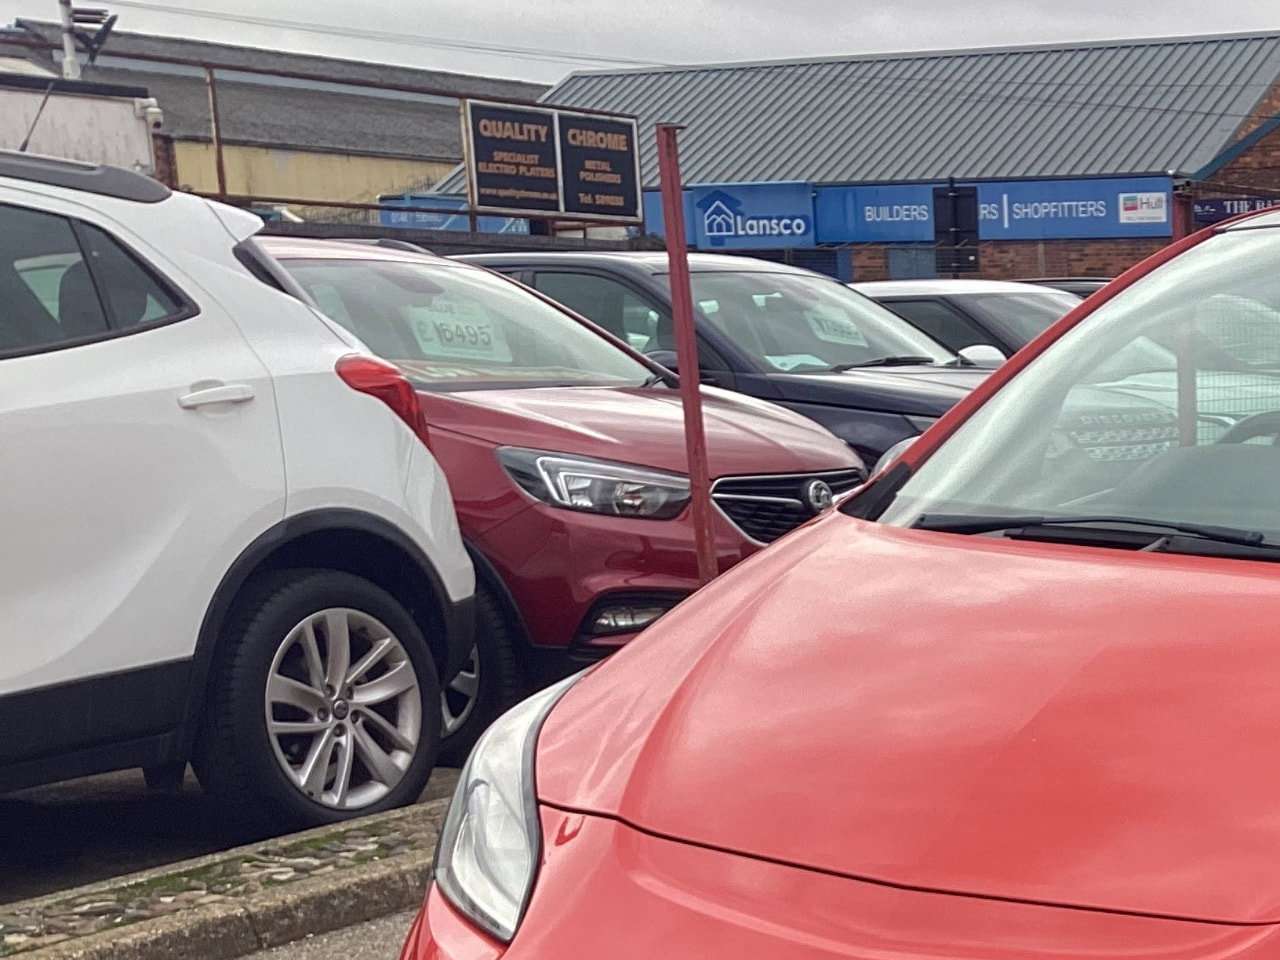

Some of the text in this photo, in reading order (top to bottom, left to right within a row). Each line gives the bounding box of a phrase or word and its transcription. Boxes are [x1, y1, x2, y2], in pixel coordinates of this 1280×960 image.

[479, 118, 628, 151] QUALITY CHROME
[478, 161, 517, 175] ELECTRO
[493, 151, 541, 164] SPECIALIST
[864, 204, 929, 222] BUILDERS
[1012, 200, 1107, 219] SHOPFITTERS
[736, 214, 806, 236] Lansco
